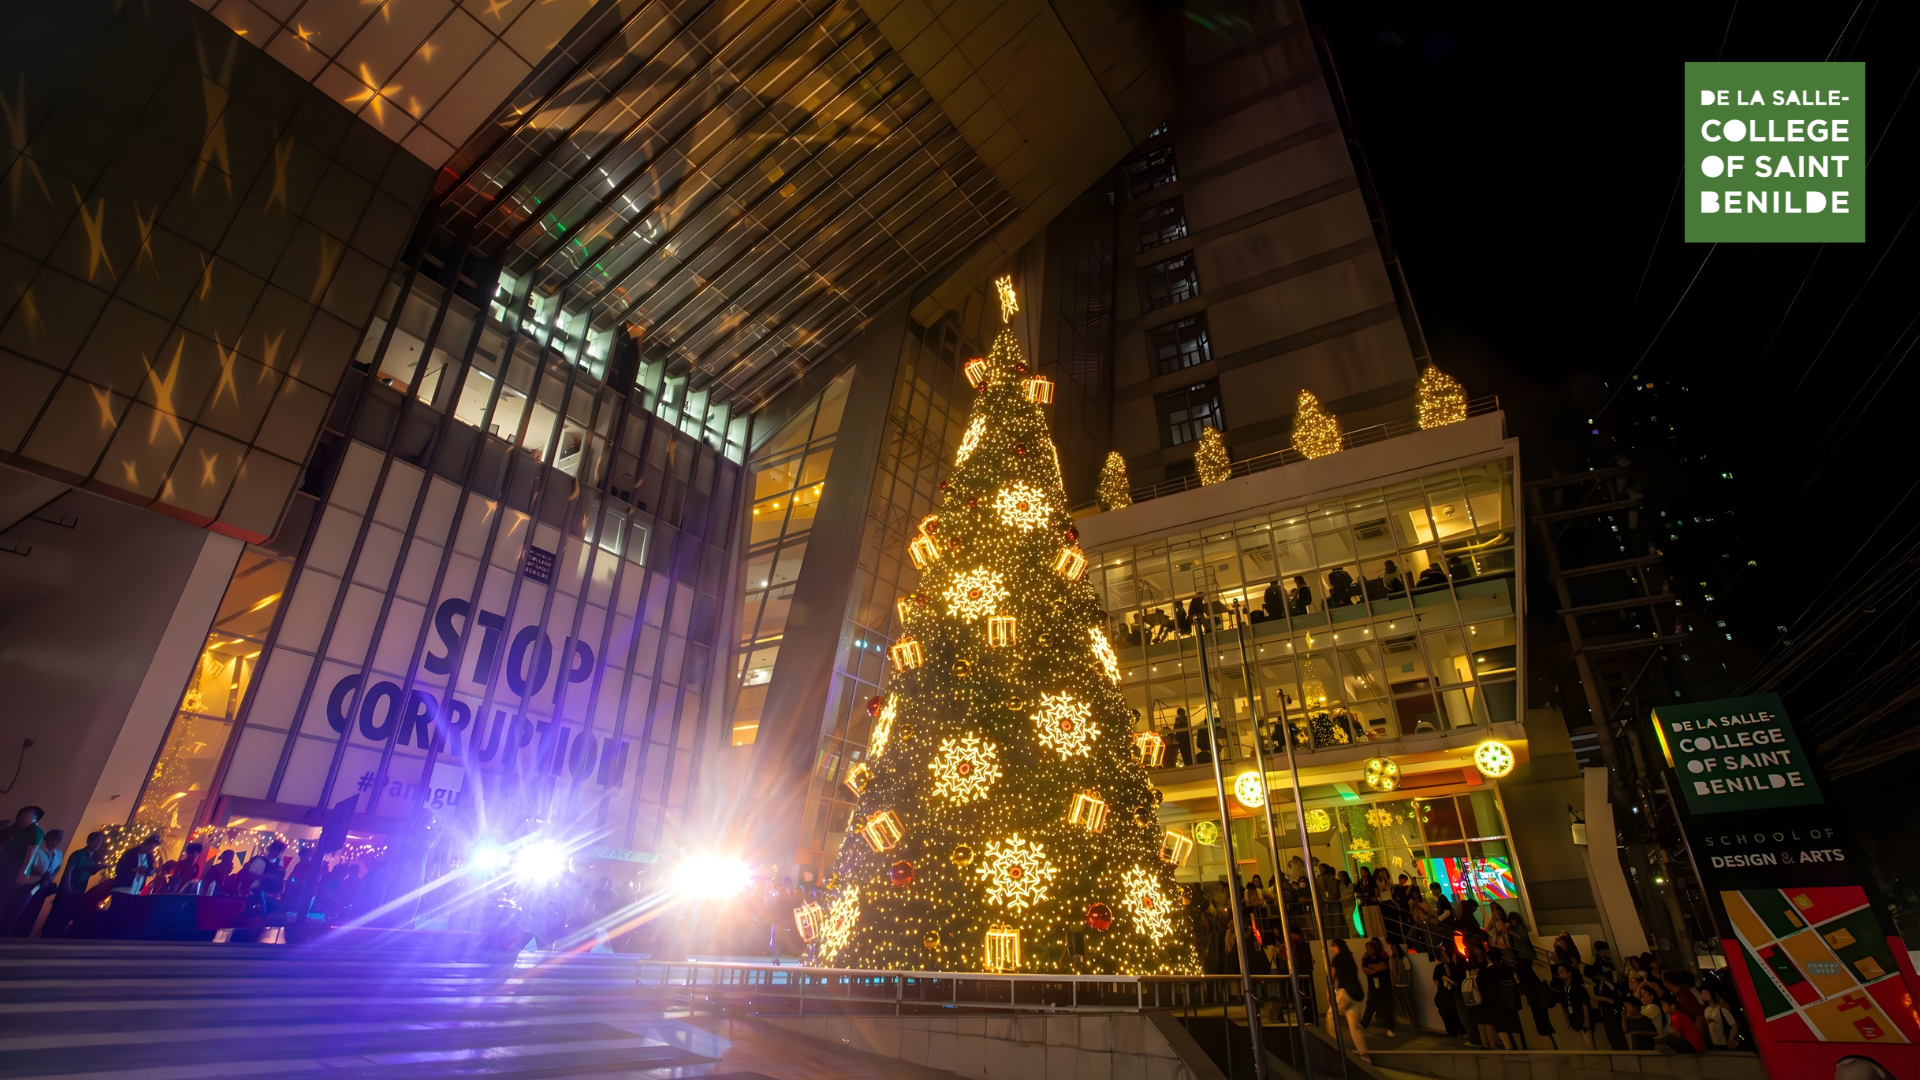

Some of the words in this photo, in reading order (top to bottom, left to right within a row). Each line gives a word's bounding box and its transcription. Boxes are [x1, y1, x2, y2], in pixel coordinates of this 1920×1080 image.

[424, 597, 595, 704] STOP
[326, 673, 630, 789] CORRUPTION
[1671, 720, 1694, 733] DE
[1696, 718, 1718, 730] LA
[1720, 711, 1775, 727] SALLE-
[1679, 728, 1786, 753] COLLEGE
[1687, 757, 1717, 774] OF
[1723, 750, 1791, 770] SAINT
[1693, 771, 1805, 796] BENILDE
[1705, 830, 1801, 847] SCHOOL
[1810, 828, 1834, 839] OF
[1711, 852, 1777, 869] DESIGN
[1781, 852, 1795, 864] &
[1800, 848, 1845, 863] ARTS
